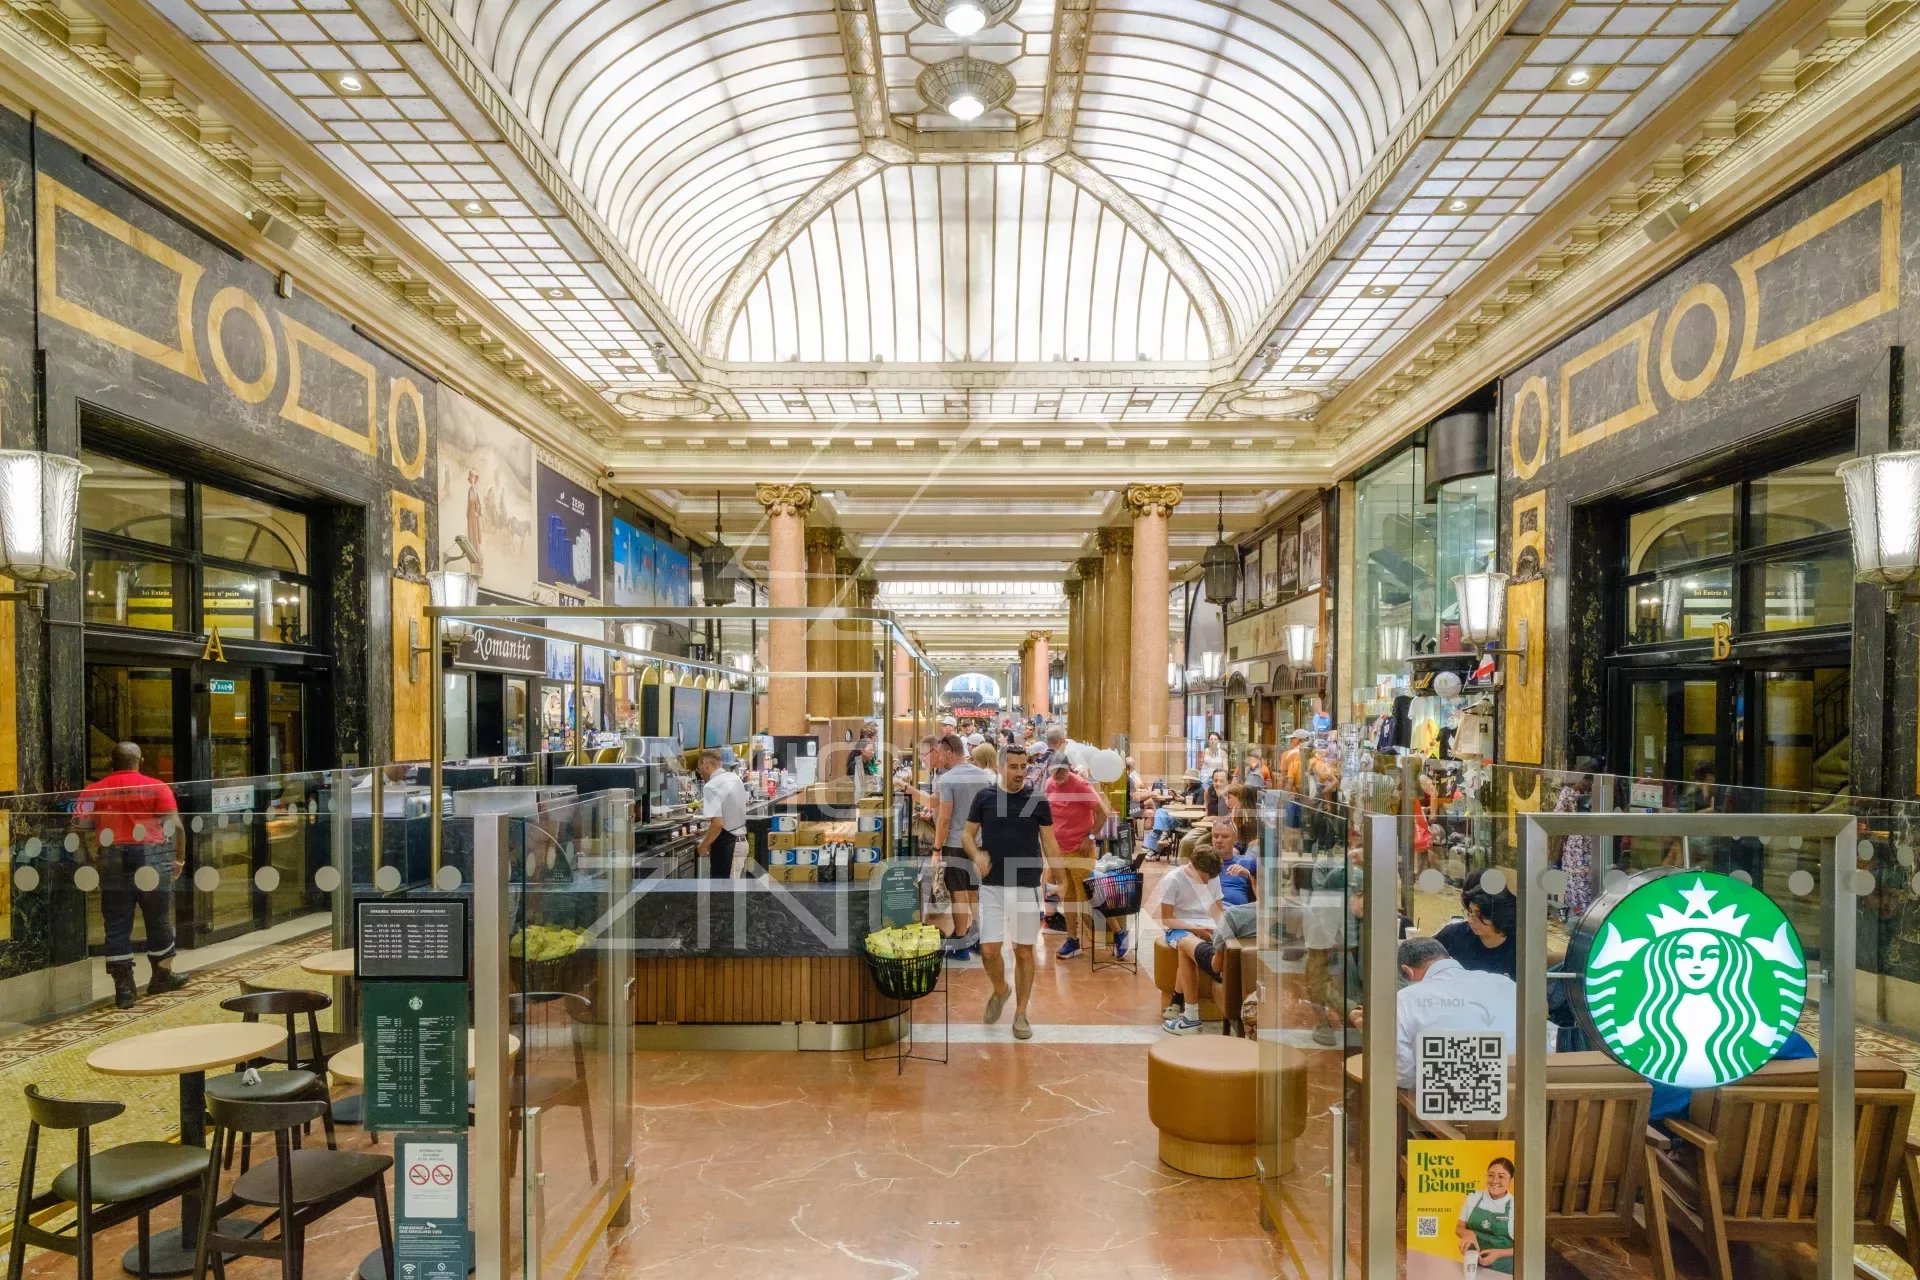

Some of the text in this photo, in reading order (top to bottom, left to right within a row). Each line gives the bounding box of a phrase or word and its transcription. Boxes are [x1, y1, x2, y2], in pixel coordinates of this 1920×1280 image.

[572, 497, 585, 512] ZERO
[202, 624, 228, 663] A
[473, 628, 532, 661] Romantic
[1712, 622, 1732, 662] B
[1416, 1152, 1455, 1172] Here
